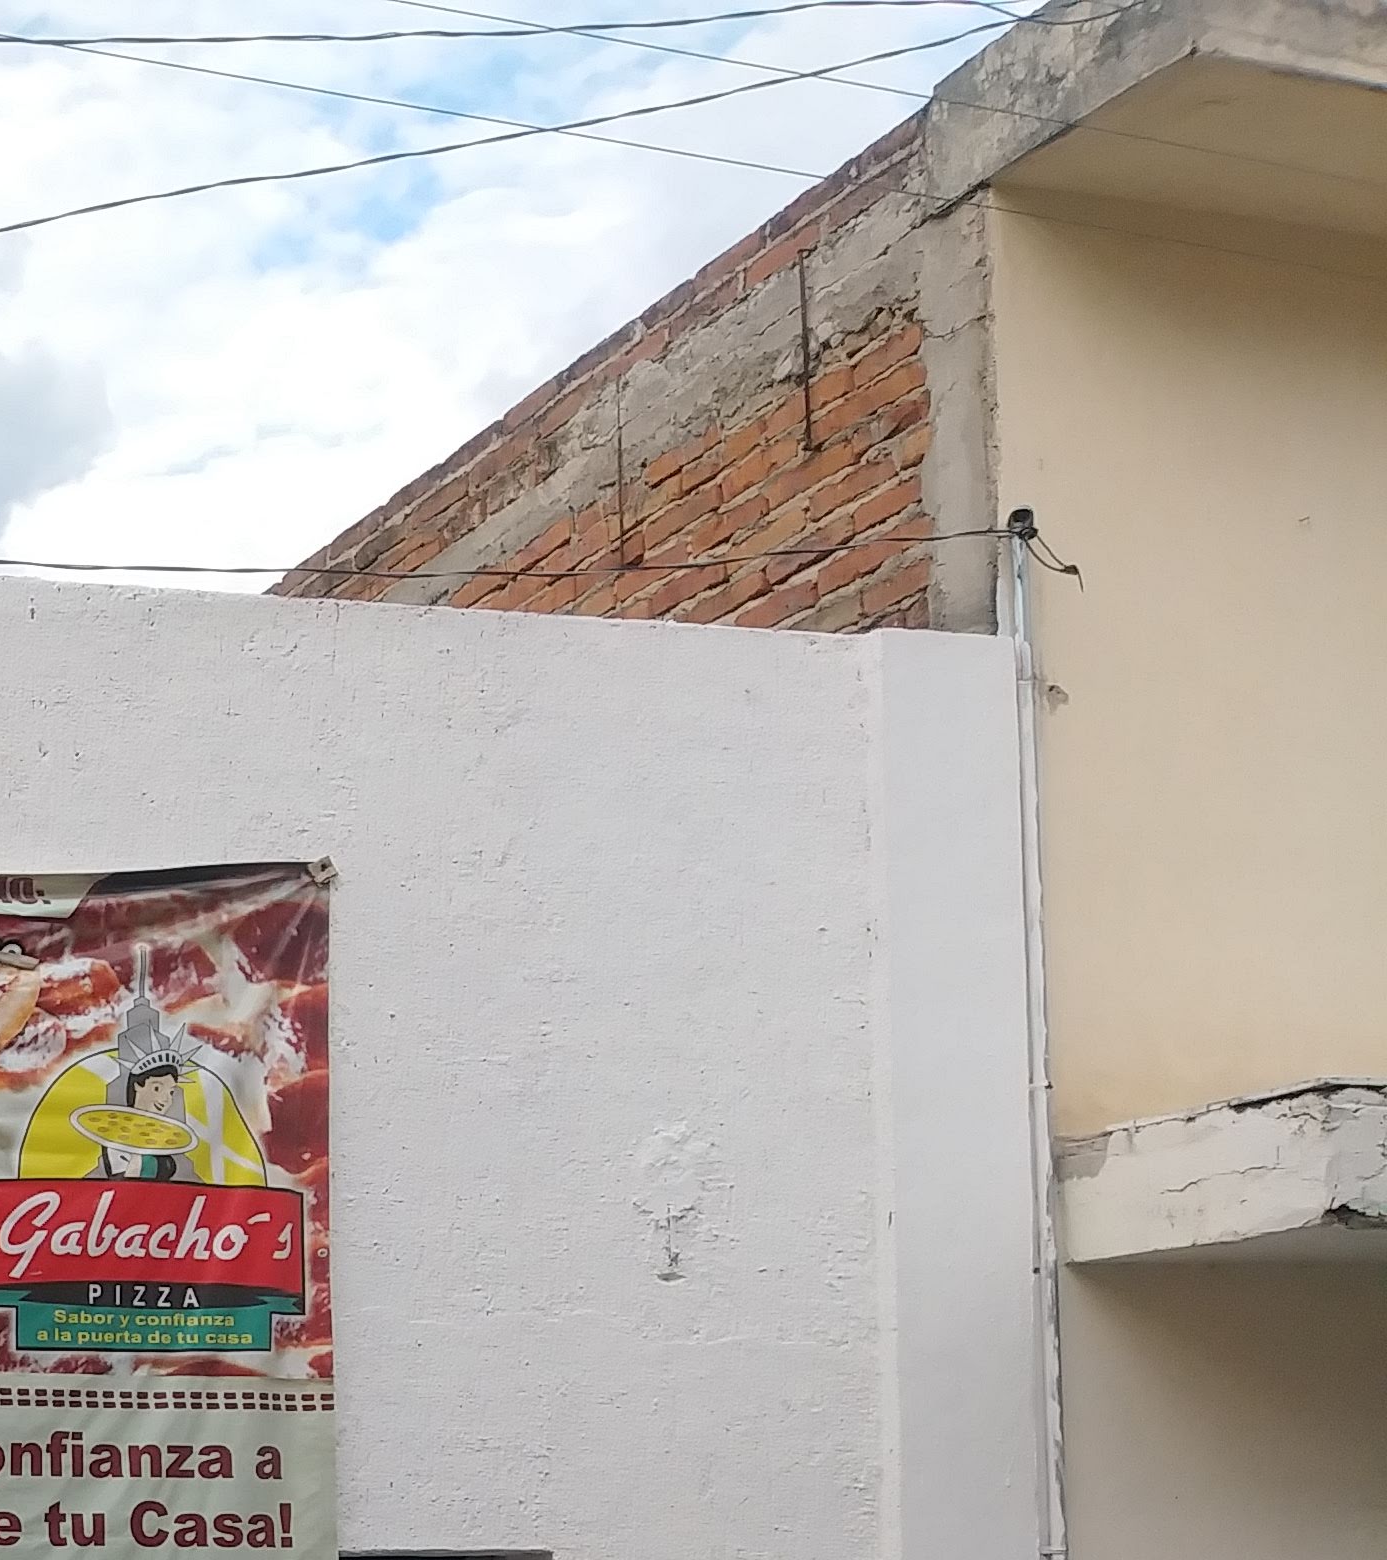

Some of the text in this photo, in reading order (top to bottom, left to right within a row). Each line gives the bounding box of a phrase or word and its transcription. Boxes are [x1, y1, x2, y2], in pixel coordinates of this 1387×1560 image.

[88, 1283, 200, 1308] PIZZA
[54, 1310, 236, 1328] Sabor y confianza
[36, 1328, 253, 1347] a la puerta de tu casa
[254, 1442, 284, 1480] a
[44, 1504, 107, 1547] tu
[130, 1501, 296, 1549] Casa!
